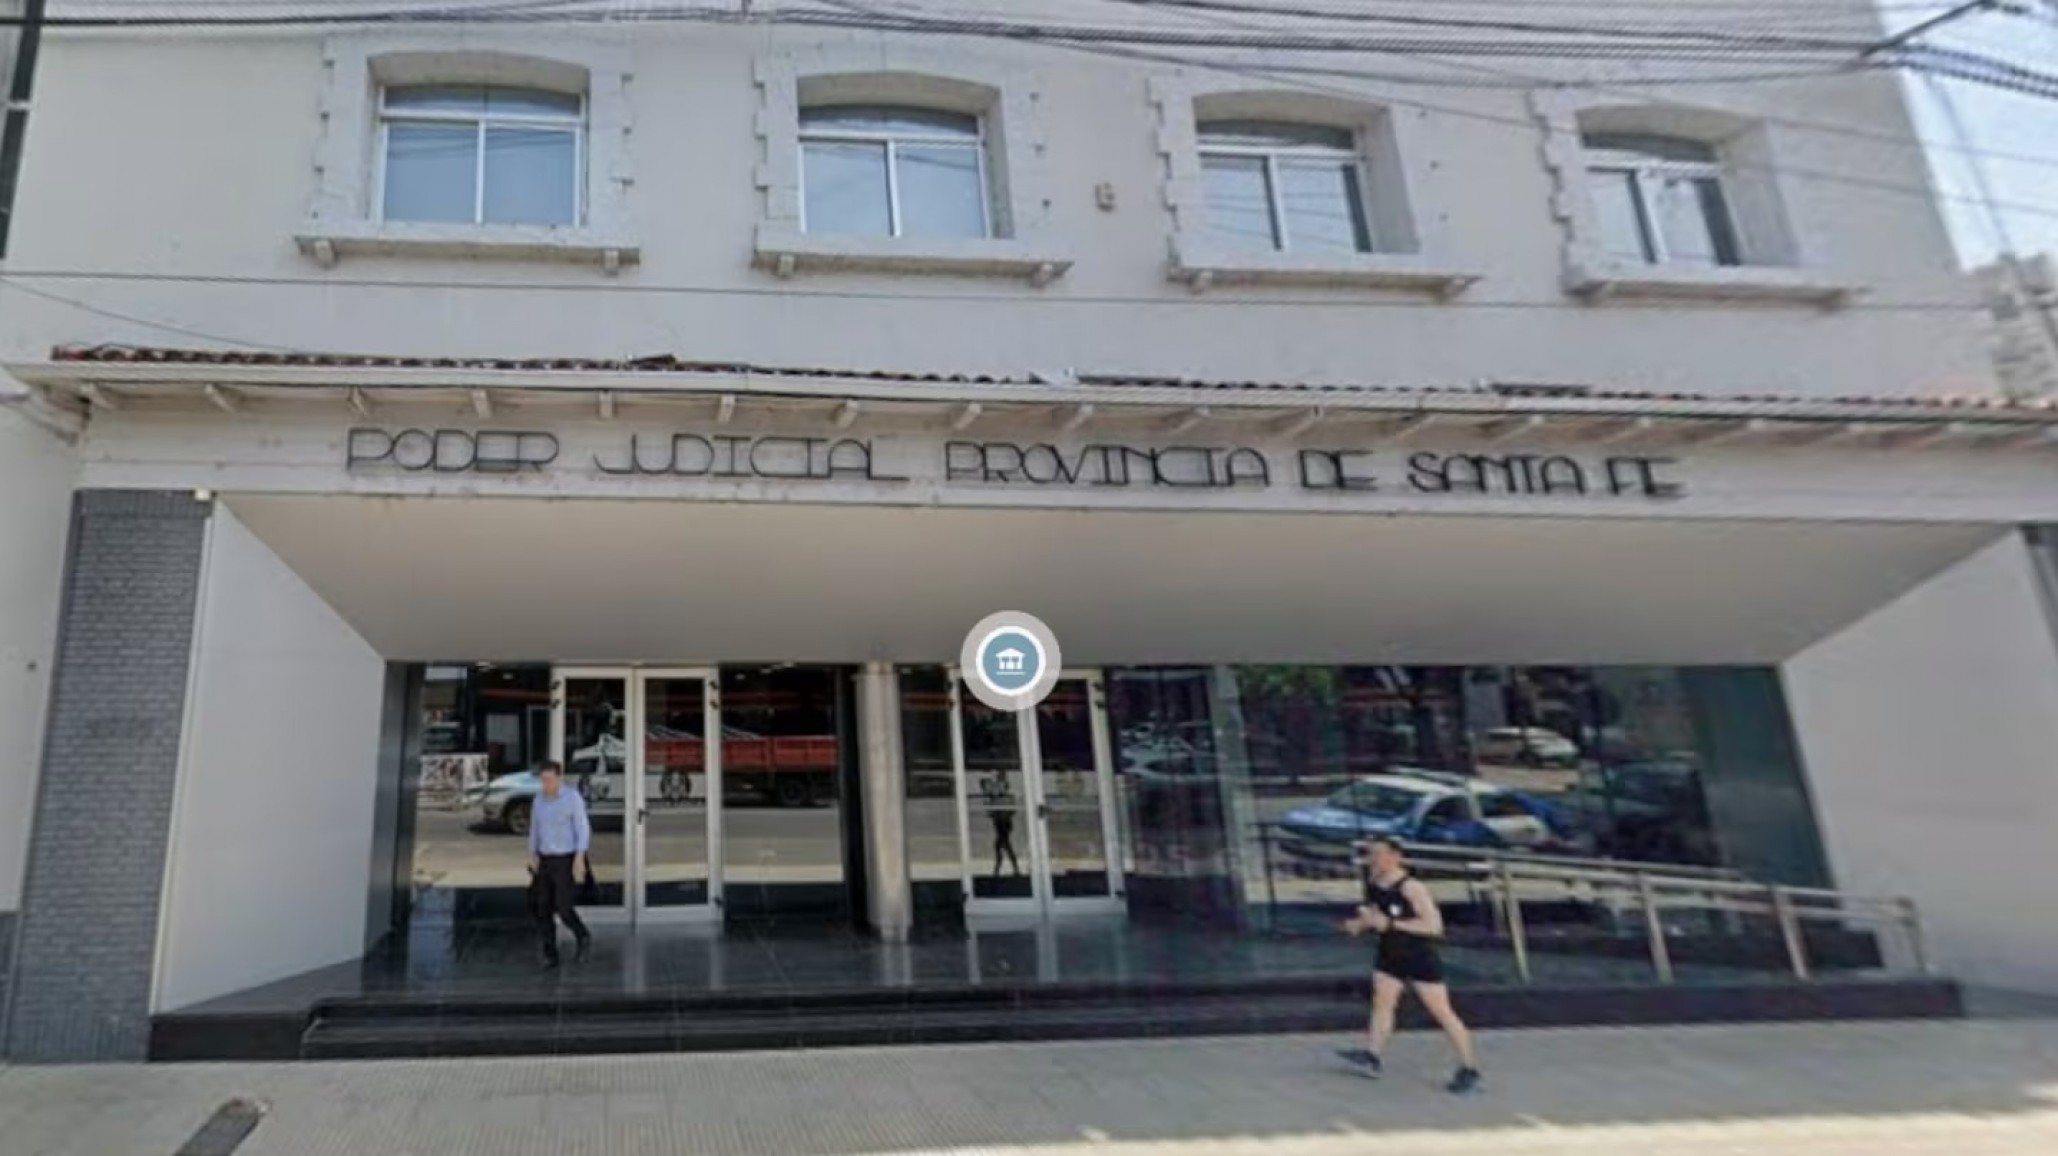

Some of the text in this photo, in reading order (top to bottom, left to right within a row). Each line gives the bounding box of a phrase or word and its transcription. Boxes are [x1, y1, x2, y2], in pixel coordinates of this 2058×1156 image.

[346, 427, 1684, 497] PODER JUDICIAL PROVINCIA DE SANTA FE
